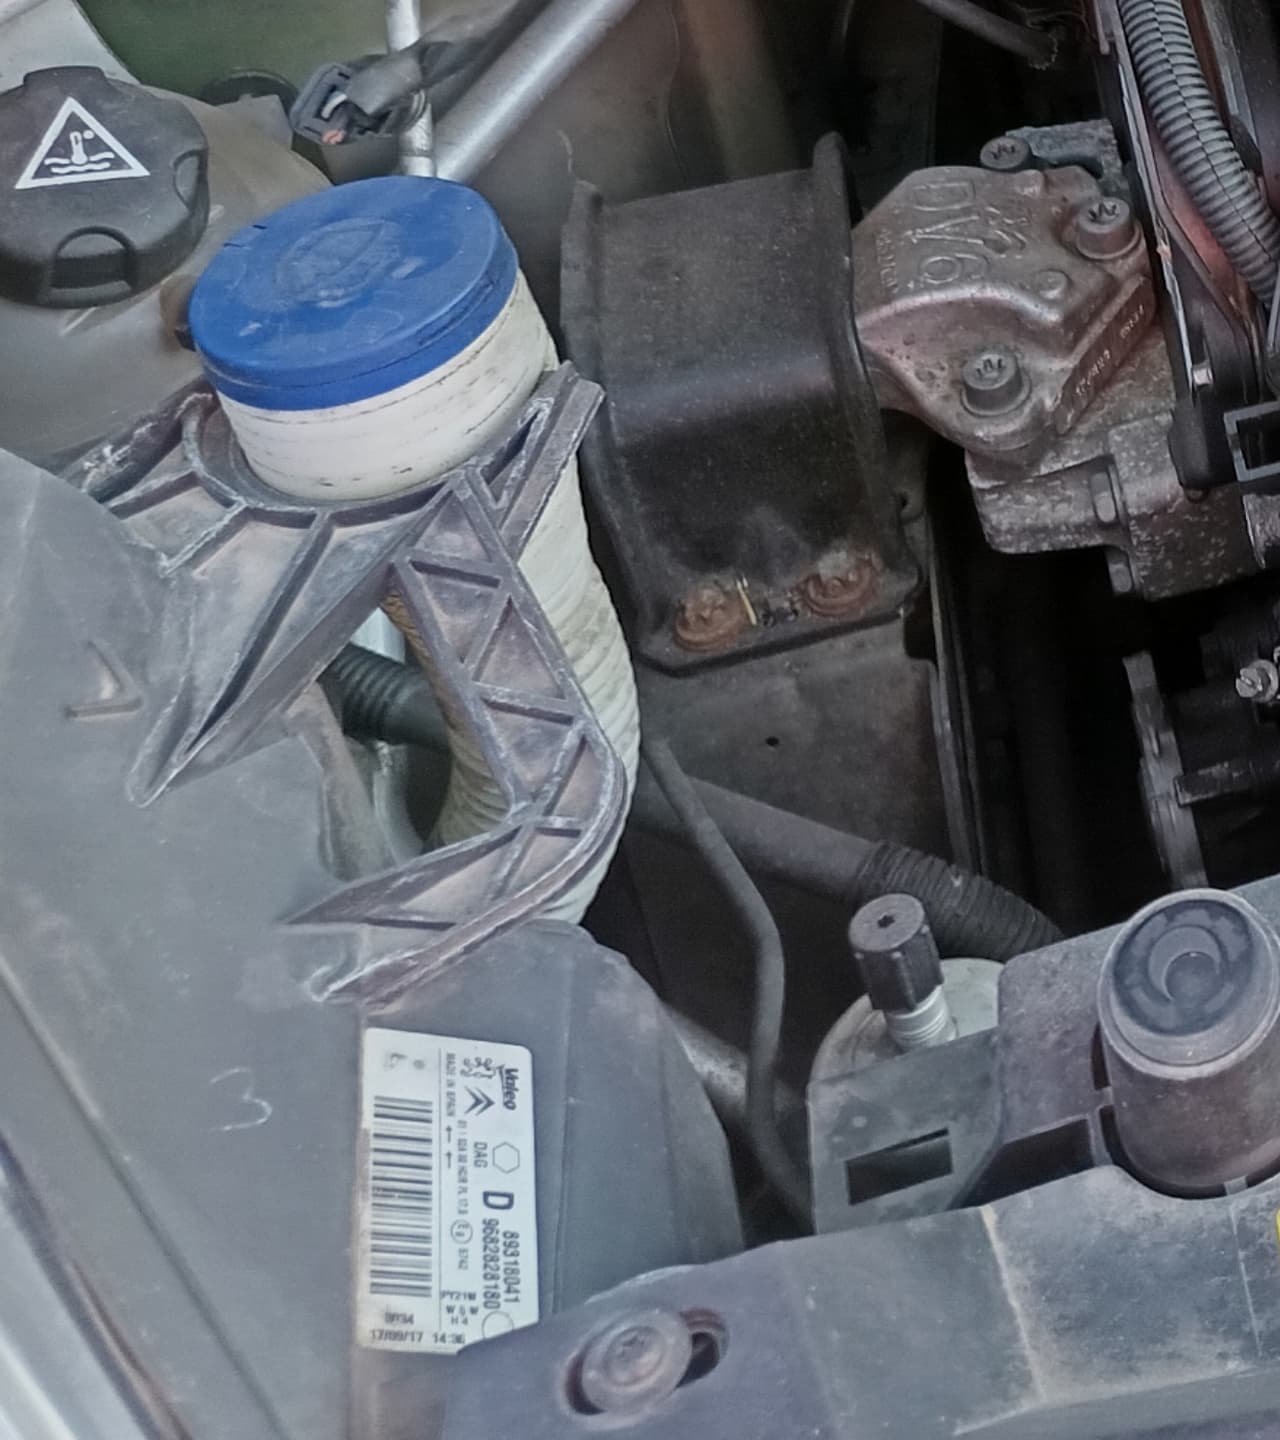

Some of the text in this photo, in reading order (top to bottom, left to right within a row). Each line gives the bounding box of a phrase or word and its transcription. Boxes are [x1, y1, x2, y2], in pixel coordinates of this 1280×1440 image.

[473, 1141, 488, 1169] DAG
[482, 1190, 515, 1210] D
[482, 1218, 501, 1310] 9682828180
[502, 1230, 521, 1303] 89318041
